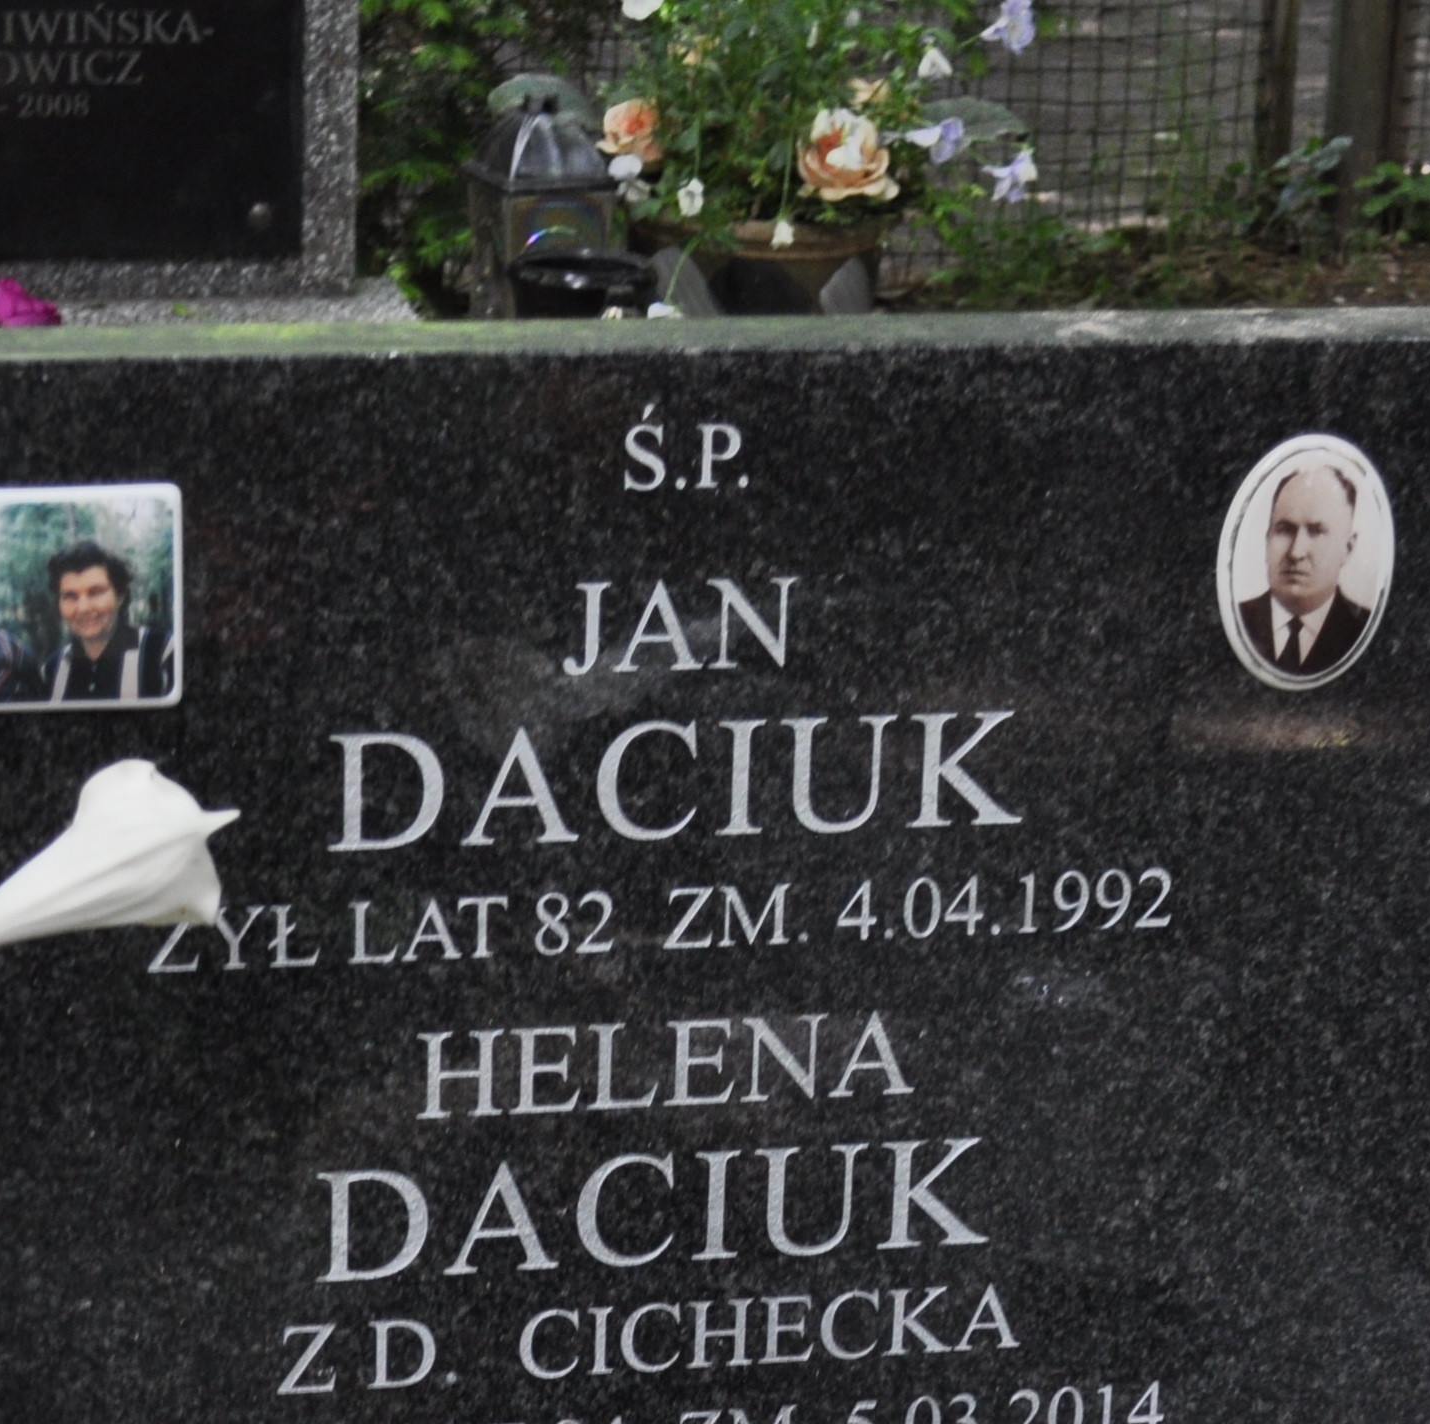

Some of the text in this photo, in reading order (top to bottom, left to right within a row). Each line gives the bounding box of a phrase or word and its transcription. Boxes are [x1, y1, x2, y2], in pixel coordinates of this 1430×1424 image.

[17, 92, 91, 120] 2008
[562, 576, 798, 677] JAN
[328, 709, 1024, 853] DACIUK
[348, 895, 509, 965] LAT
[534, 891, 614, 956] 82
[662, 882, 810, 951] ZM.
[836, 867, 1172, 942] 4.04.1992
[416, 1011, 915, 1120] HELENA
[316, 1136, 989, 1284] DACIUK
[518, 1284, 1021, 1380] CICHECKA
